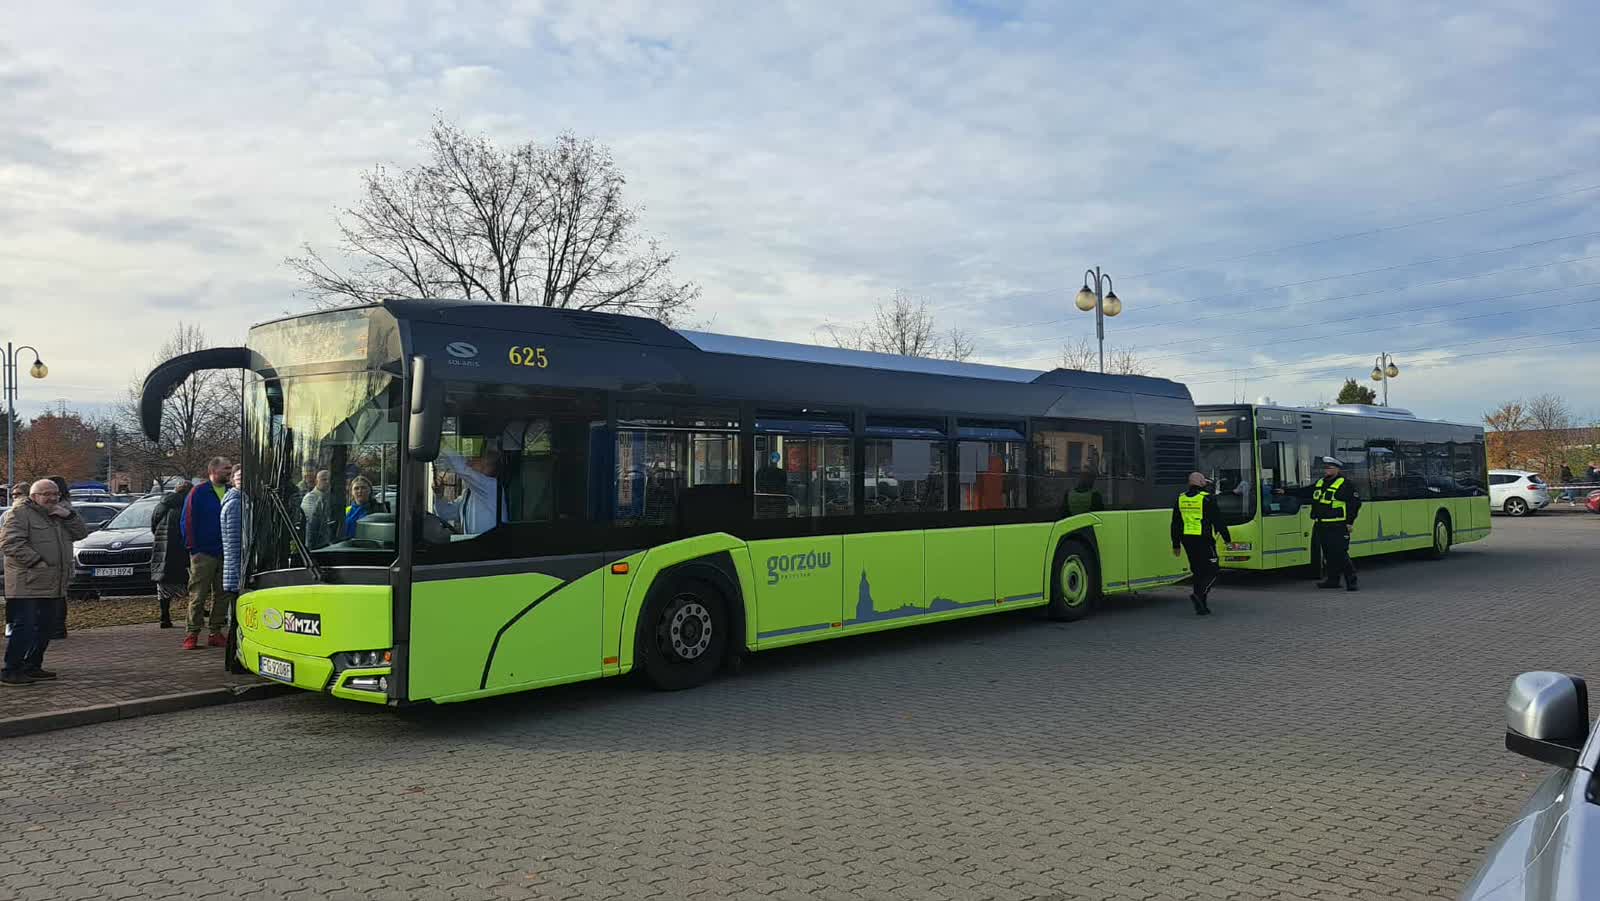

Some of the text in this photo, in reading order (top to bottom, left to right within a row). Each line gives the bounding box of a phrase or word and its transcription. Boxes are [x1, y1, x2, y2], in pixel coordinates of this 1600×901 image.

[508, 346, 549, 369] 625
[767, 549, 831, 586] gorzów
[295, 618, 320, 635] MZK
